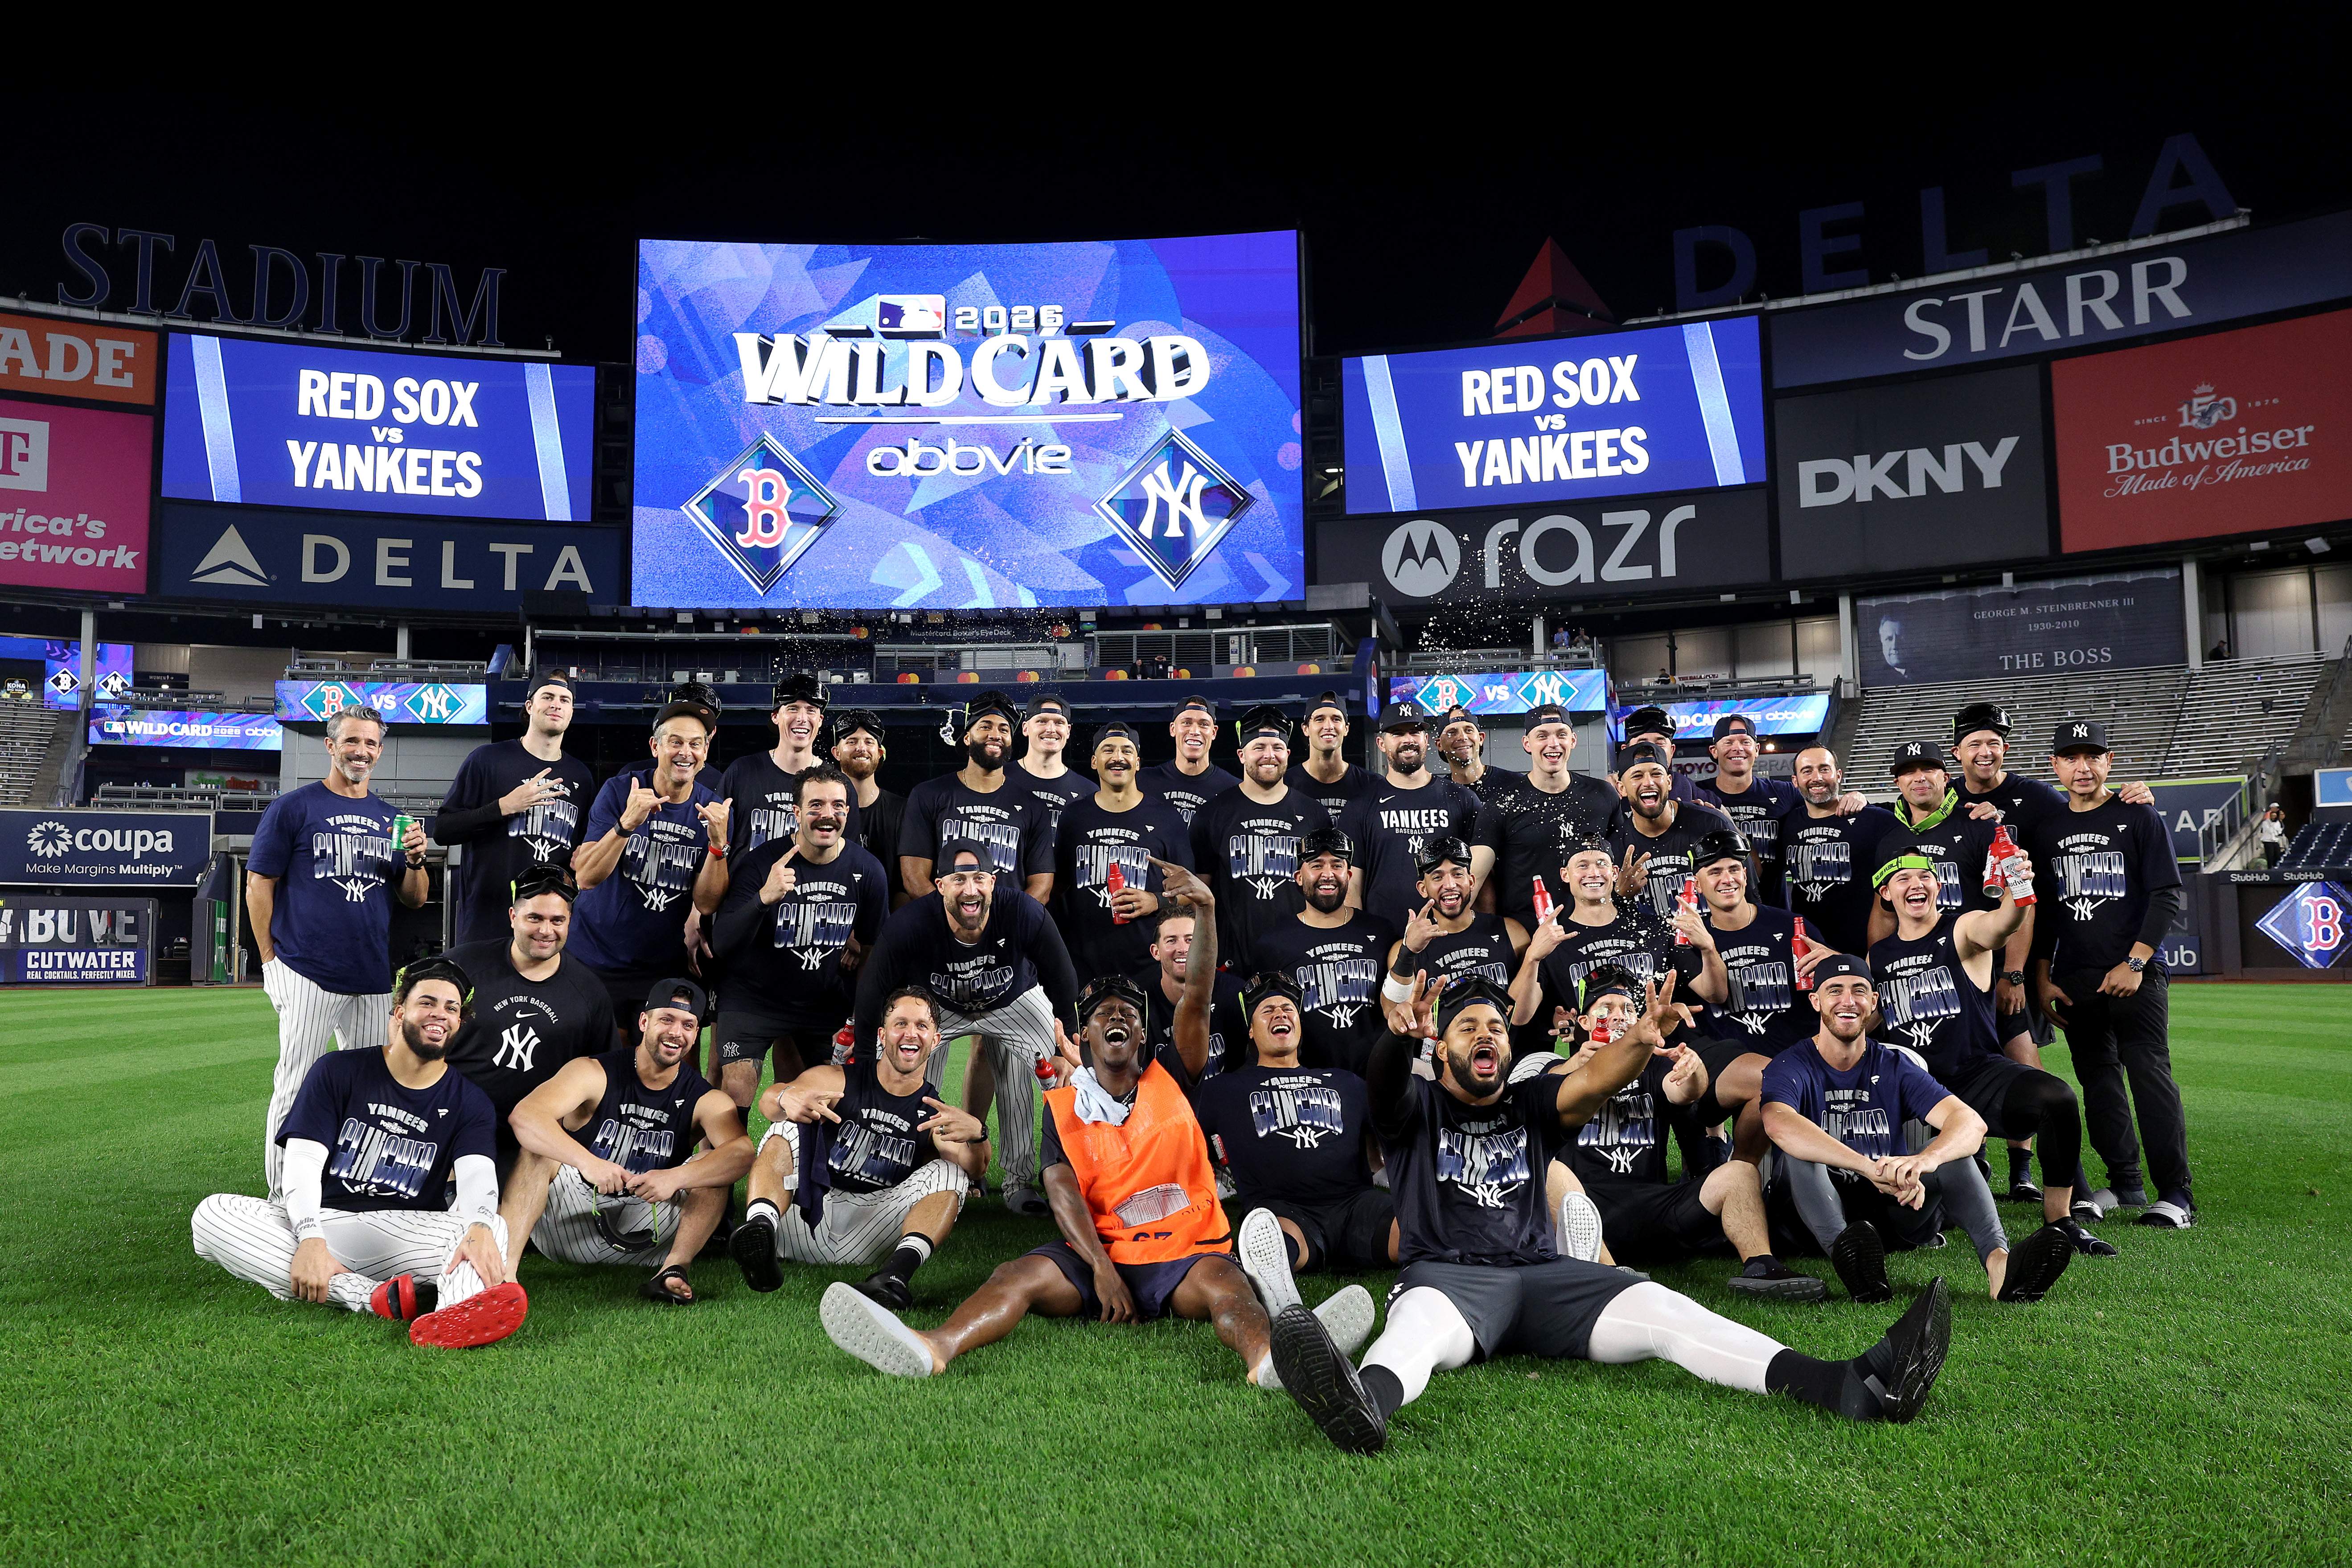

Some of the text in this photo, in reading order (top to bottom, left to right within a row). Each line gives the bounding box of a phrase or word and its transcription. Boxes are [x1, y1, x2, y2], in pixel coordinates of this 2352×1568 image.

[1673, 133, 2238, 313] DELTA
[58, 223, 507, 347] STADIUM
[954, 303, 1064, 335] 2026
[1903, 255, 2192, 361] STARR
[733, 332, 1211, 406] WILD CARD
[298, 368, 479, 428] RED SOX
[1462, 354, 1640, 417] RED SOX
[2134, 415, 2167, 426] SINCE
[2247, 398, 2280, 408] 1876
[866, 436, 1072, 477] abbvie
[1455, 426, 1650, 487] YANKEES
[2106, 423, 2314, 474] Budweiser
[287, 440, 483, 498] YANKEES
[1798, 436, 2020, 508] DKNY
[2104, 455, 2311, 499] Made of America
[735, 467, 792, 548] B
[1137, 460, 1212, 539] NY
[1484, 505, 1695, 588] razr
[302, 533, 594, 594] DELTA
[1974, 598, 2134, 620] GEORGE M. STEINBRENNER III
[2028, 620, 2080, 632] 1930-2010
[2000, 647, 2113, 671] THE BOSS
[1399, 704, 1412, 717] NY
[2073, 723, 2089, 738] NY
[1907, 742, 1921, 756] NY
[1032, 791, 1067, 805] NKEES
[325, 815, 380, 831] YANKEES
[957, 806, 1010, 820] YANKEES
[1241, 819, 1292, 830] YANKEES
[1379, 809, 1449, 829] YANKEES
[75, 829, 173, 859] coupa
[1087, 829, 1140, 841] YANKEES
[1797, 826, 1841, 838] YANKEES
[2058, 833, 2110, 849] YANKEES
[533, 838, 550, 862] NY
[26, 863, 61, 874] Make
[65, 863, 115, 877] Margins
[2230, 872, 2324, 882] StubHub StubHub
[345, 878, 365, 902] NY
[644, 888, 668, 912] NY
[1256, 876, 1274, 900] NY
[1806, 883, 1823, 903] NY
[2074, 897, 2093, 922] NY
[774, 903, 857, 949] CLINCHED
[2301, 896, 2344, 951] B
[27, 951, 135, 968] CUTWATER
[801, 947, 821, 970] NY
[1306, 943, 1363, 957] YANKEES
[1436, 948, 1489, 968] YANKEES
[1578, 939, 1635, 955] YANKEES
[27, 970, 136, 979] REAL COCKTAILS. PERFECTLY MIXED.
[1885, 954, 1933, 973] YANKEES
[1296, 960, 1377, 1012] CLINCHED
[493, 996, 559, 1025] NEW YORK BASEBALL
[1332, 1004, 1353, 1029] NY
[1742, 1012, 1765, 1034] NY
[1913, 1022, 1933, 1047] NY
[492, 1023, 541, 1072] NY
[368, 1103, 428, 1133] YANKEES
[861, 1108, 911, 1133] YANKEES
[1250, 1087, 1343, 1138] CLINCHED
[1294, 1126, 1319, 1149] NY
[329, 1117, 438, 1199] CLINCHED
[1610, 1146, 1633, 1174] NY
